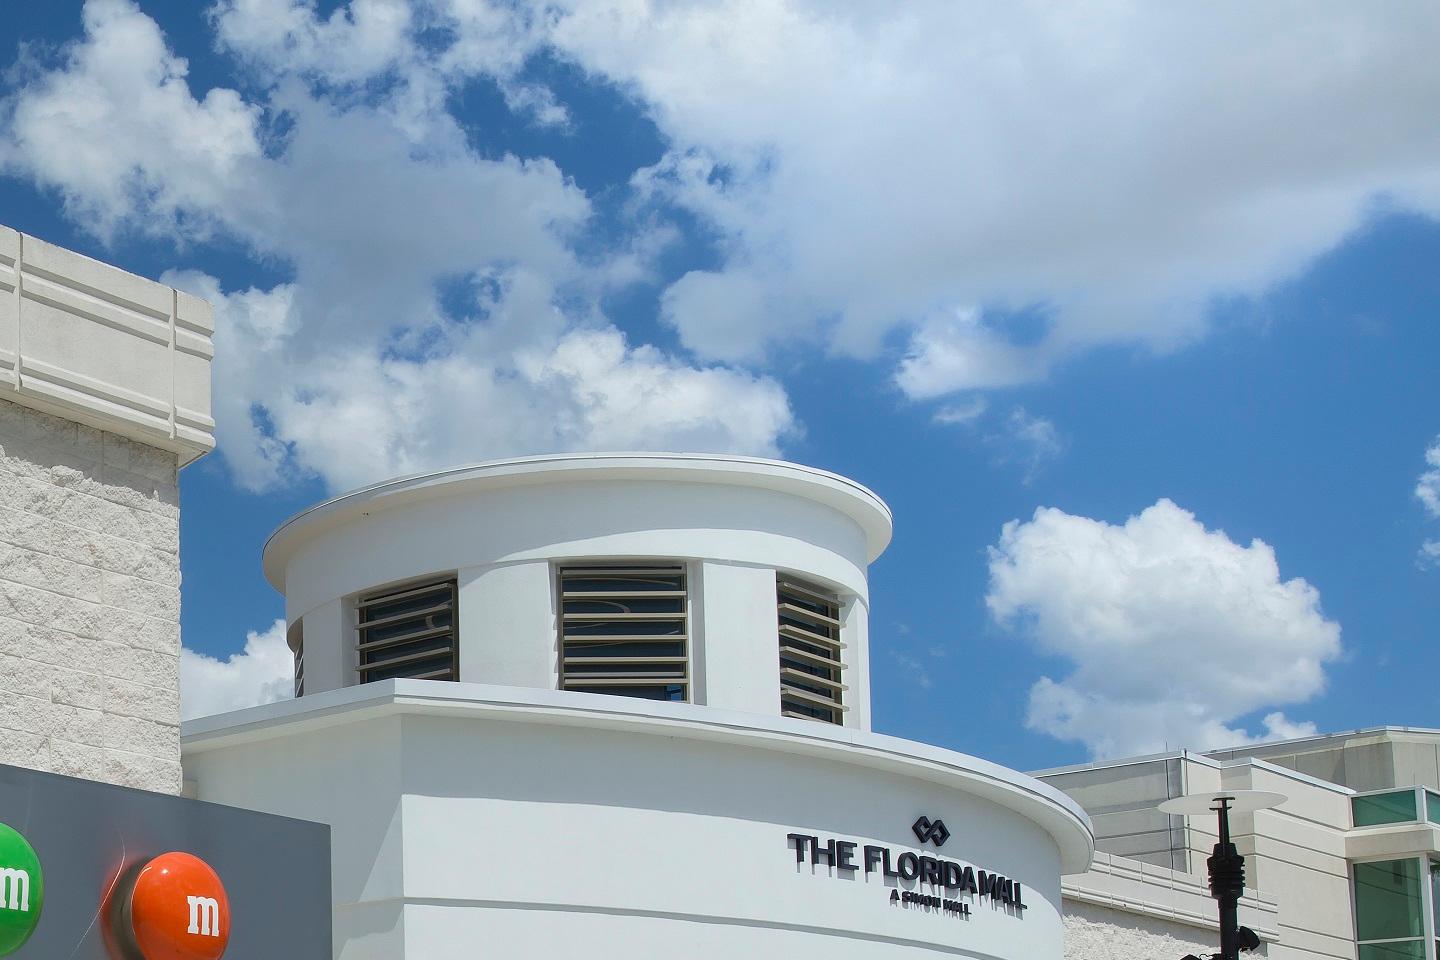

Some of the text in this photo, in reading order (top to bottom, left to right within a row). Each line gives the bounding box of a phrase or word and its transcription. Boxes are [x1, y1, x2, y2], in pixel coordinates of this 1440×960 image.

[787, 833, 860, 872] THE
[864, 844, 977, 895] FLORIDA
[187, 895, 220, 937] m
